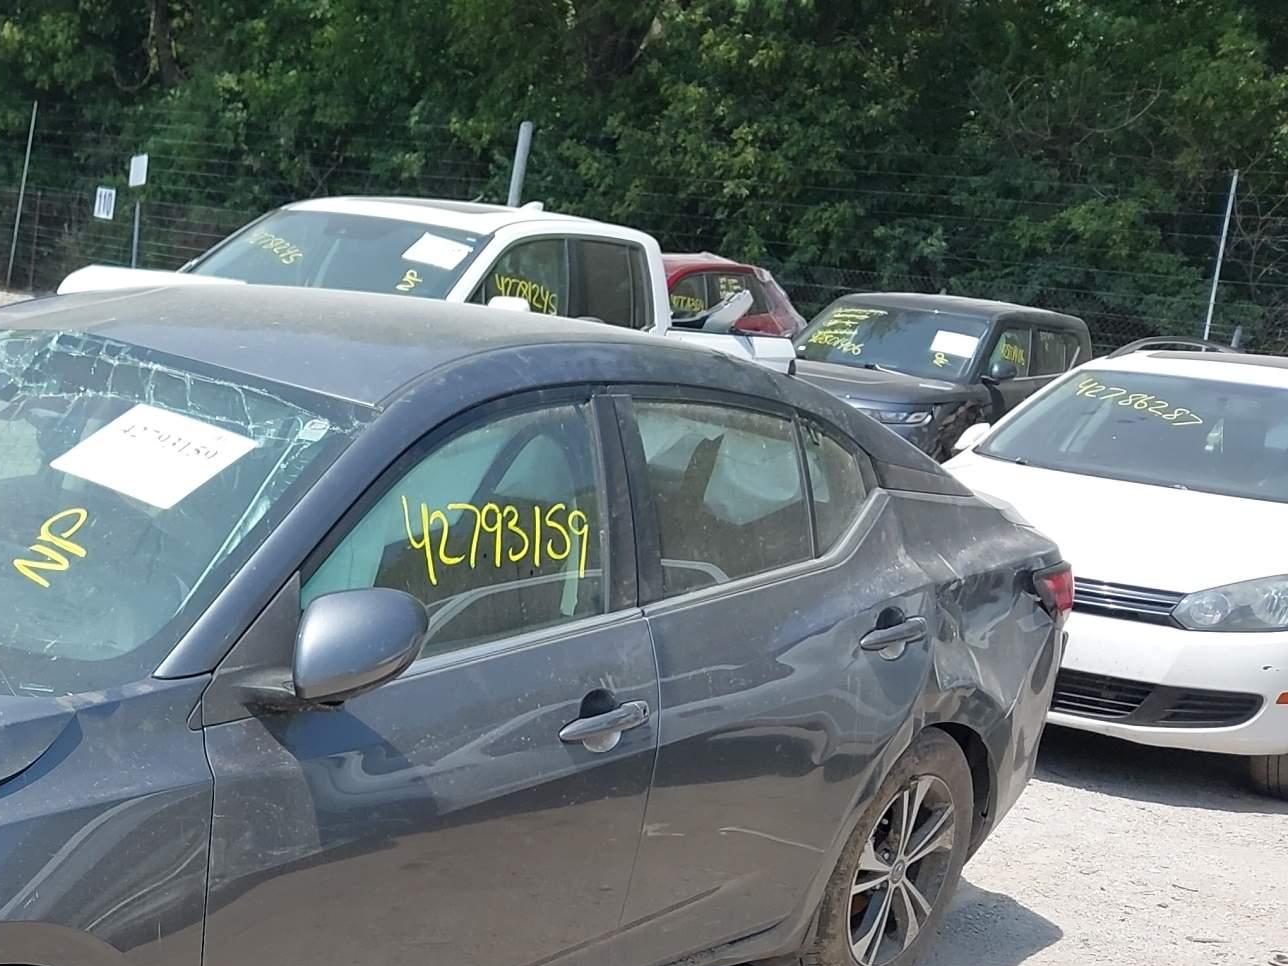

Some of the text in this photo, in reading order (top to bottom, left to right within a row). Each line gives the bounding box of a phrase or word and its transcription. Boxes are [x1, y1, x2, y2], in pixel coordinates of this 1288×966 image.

[1076, 378, 1204, 426] 42786287
[13, 508, 88, 588] NP
[401, 495, 589, 585] 42793159
